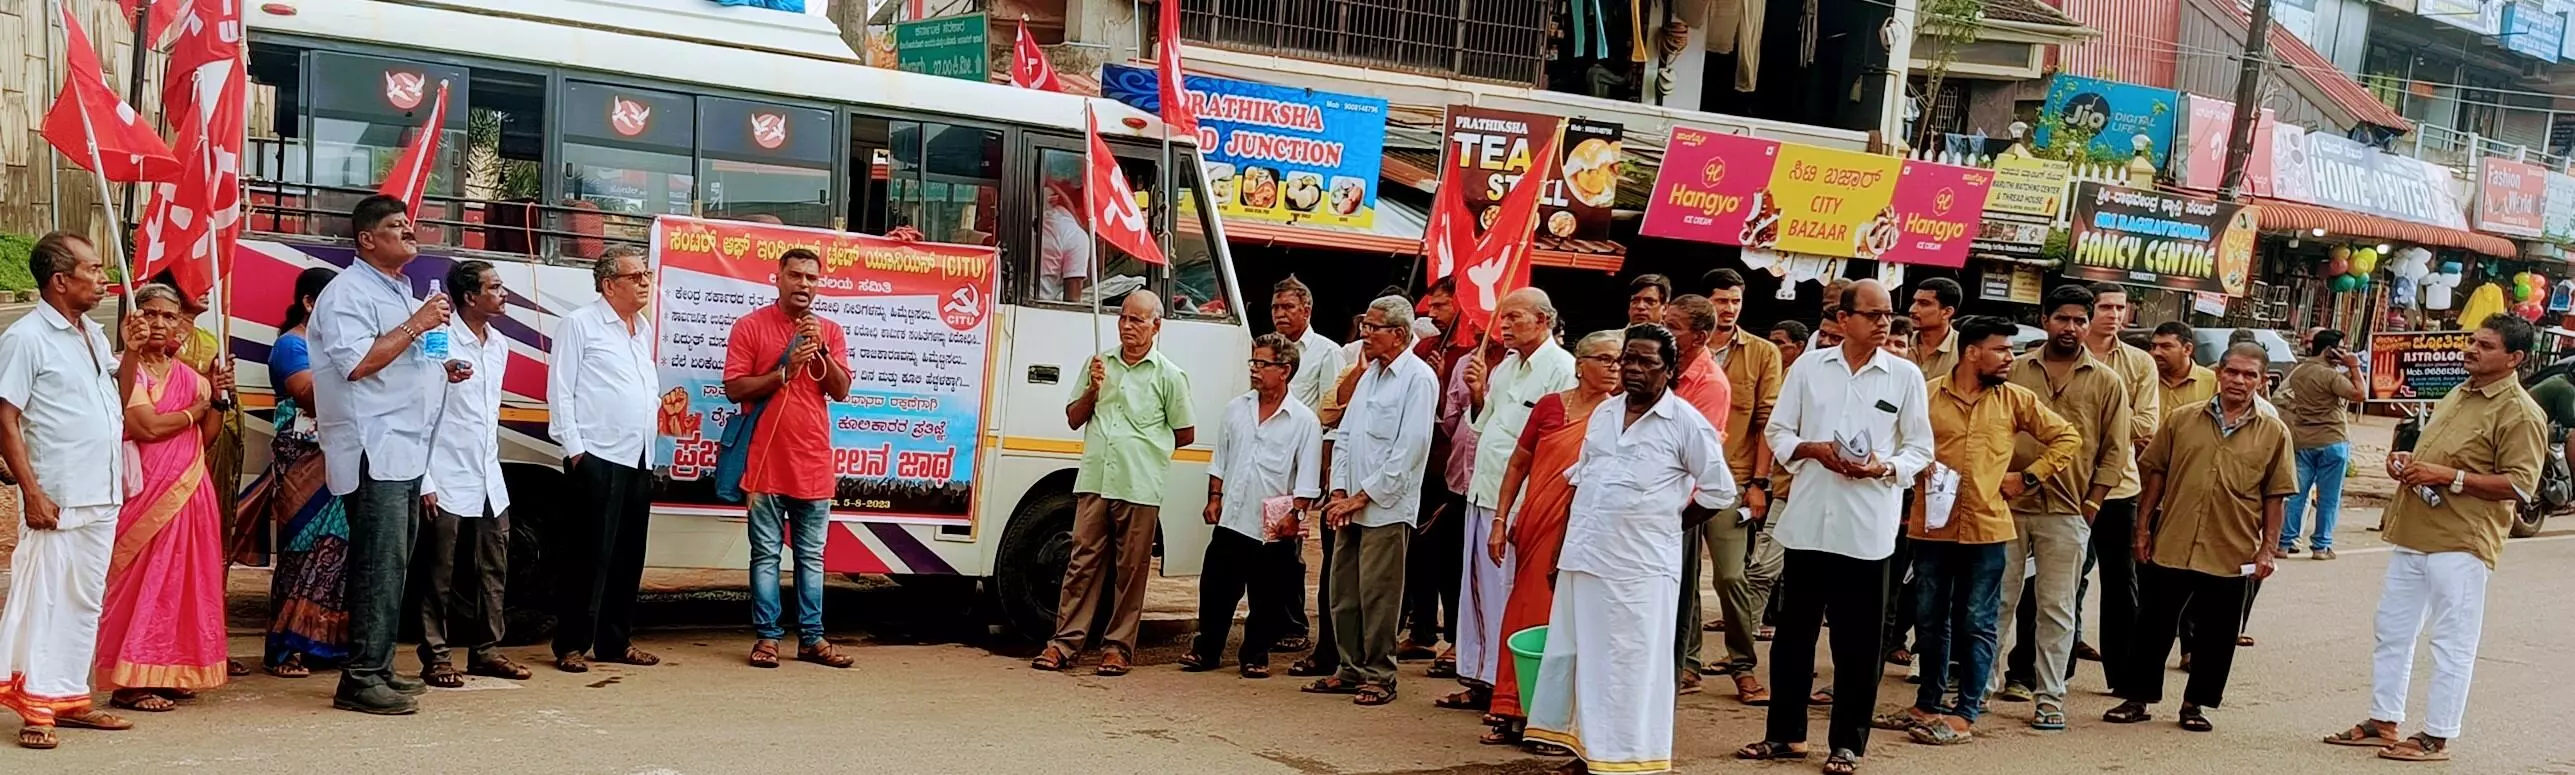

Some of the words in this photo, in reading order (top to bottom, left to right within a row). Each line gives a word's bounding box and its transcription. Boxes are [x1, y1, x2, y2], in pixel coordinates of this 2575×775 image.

[1455, 116, 1529, 134] PRATHIKSHA
[2064, 104, 2106, 130] Jio
[2112, 122, 2136, 135] LIFE
[2114, 112, 2156, 128] DIGITAL
[1228, 132, 1342, 167] JUNCTION
[1452, 131, 1532, 173] TEA
[2310, 156, 2371, 206] HOME
[2373, 172, 2438, 220] CENTER
[2488, 164, 2520, 189] Fashion
[1486, 173, 1569, 207] STLL
[1668, 183, 1740, 216] Hangyo
[1811, 195, 1844, 215] CITY
[1788, 219, 1847, 241] BAZAAR
[1904, 212, 1965, 241] Hangyo
[2074, 231, 2142, 270] FANCY
[2144, 240, 2216, 280] CENTRE
[941, 254, 988, 284] (CITU)
[858, 279, 892, 294] ಸಮಿತಿ
[946, 314, 975, 327] CITU
[878, 371, 898, 387] ಮತ್ತು
[843, 499, 891, 510] 5-8-2023
